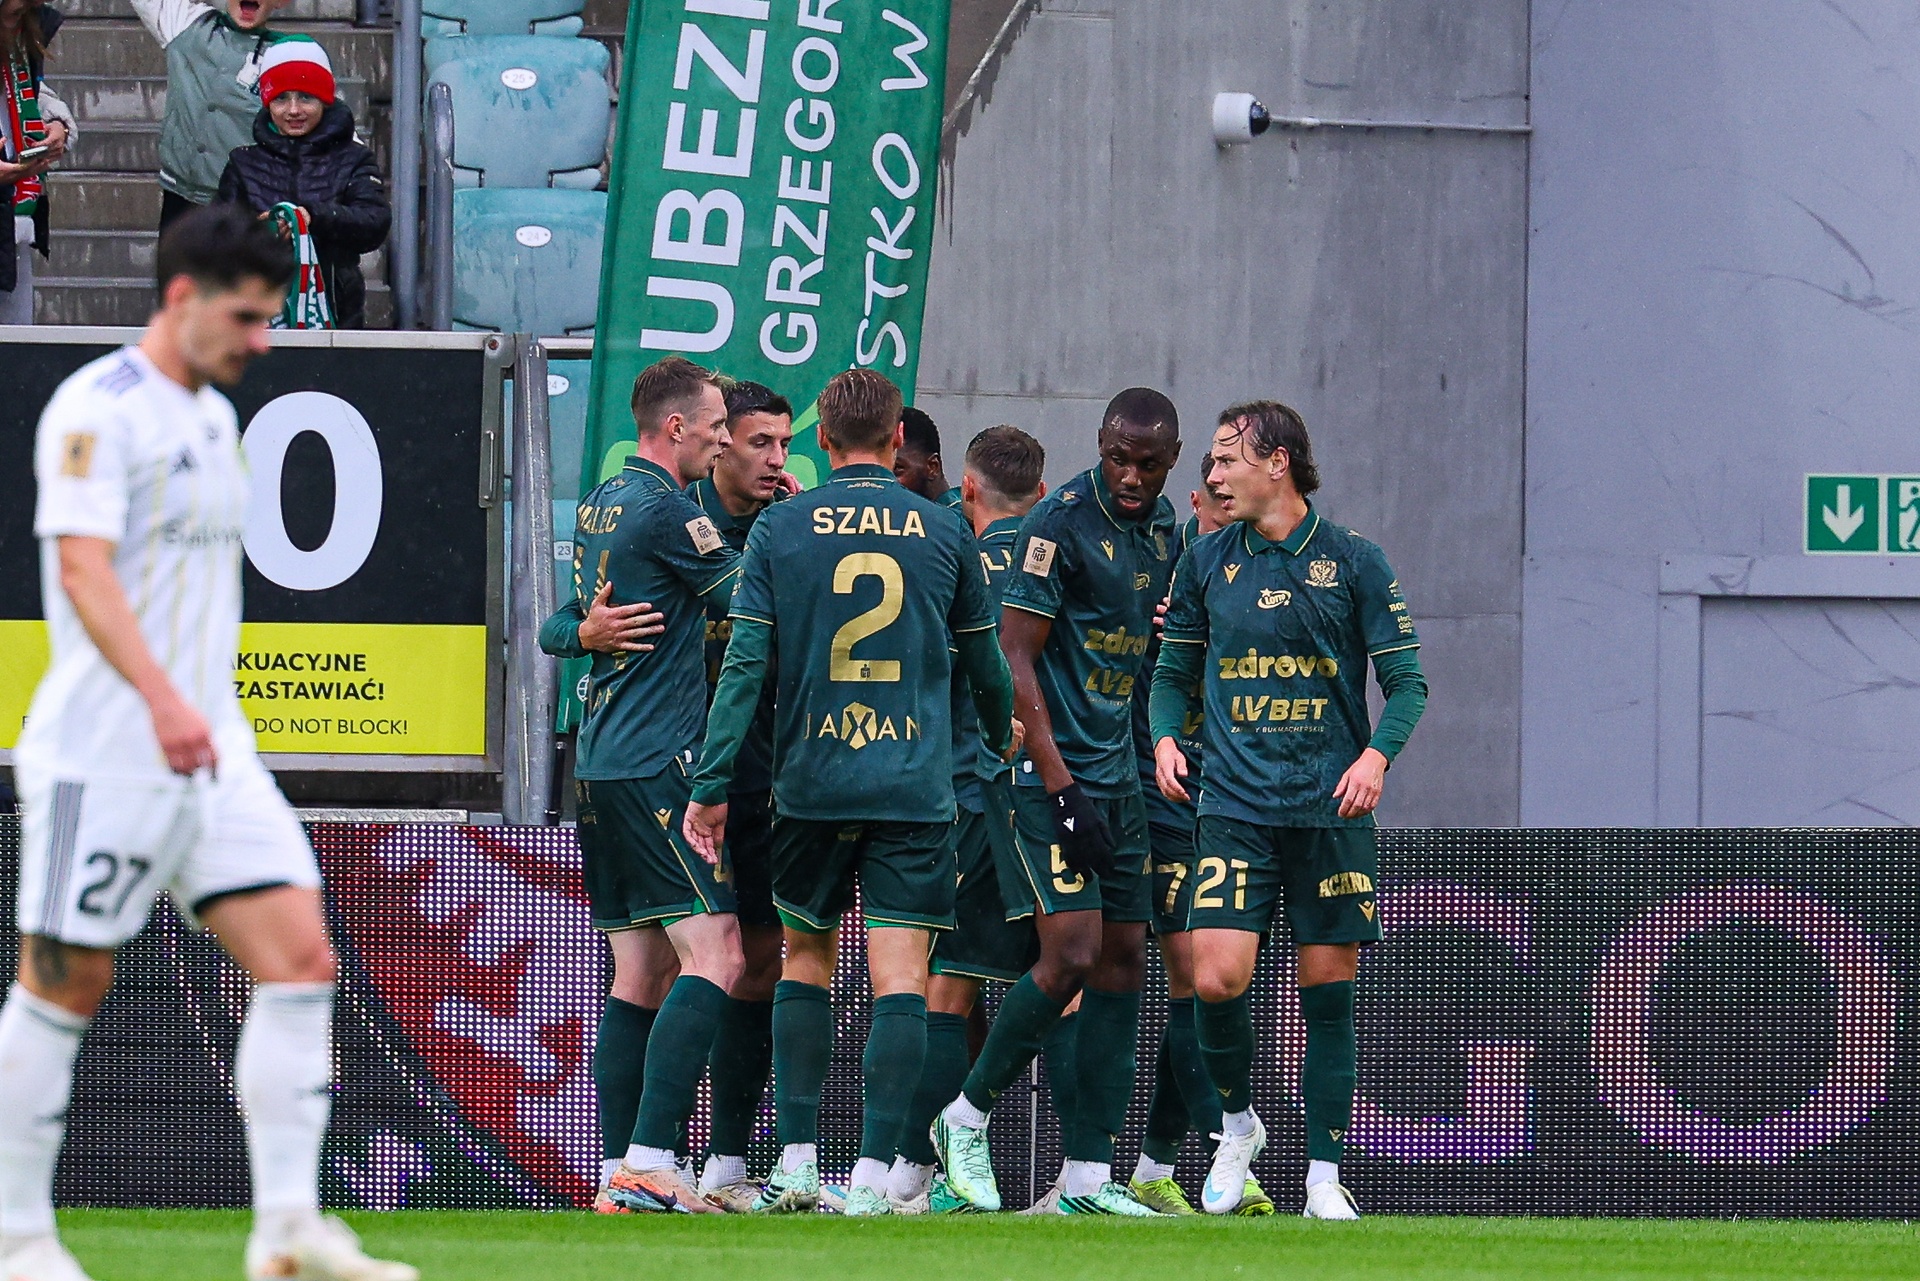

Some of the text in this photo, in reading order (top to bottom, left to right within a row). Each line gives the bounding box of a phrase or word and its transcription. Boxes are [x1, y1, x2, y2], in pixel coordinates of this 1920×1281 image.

[850, 132, 922, 370] STKO
[812, 506, 926, 538] SZALA
[557, 545, 571, 556] 23
[829, 552, 904, 682] 2
[232, 653, 367, 673] KUACYJNE
[1219, 647, 1338, 680] zdrovo
[232, 679, 385, 701] ZASTAWIAĆ!
[1230, 695, 1328, 722] LVBET
[254, 717, 408, 736] DO NOT BLOCK!
[1058, 796, 1065, 807] 5
[78, 852, 152, 916] 27
[1050, 844, 1085, 894] 5
[1193, 856, 1249, 910] 21
[1318, 871, 1374, 898] ACANA
[1157, 862, 1187, 914] 7
